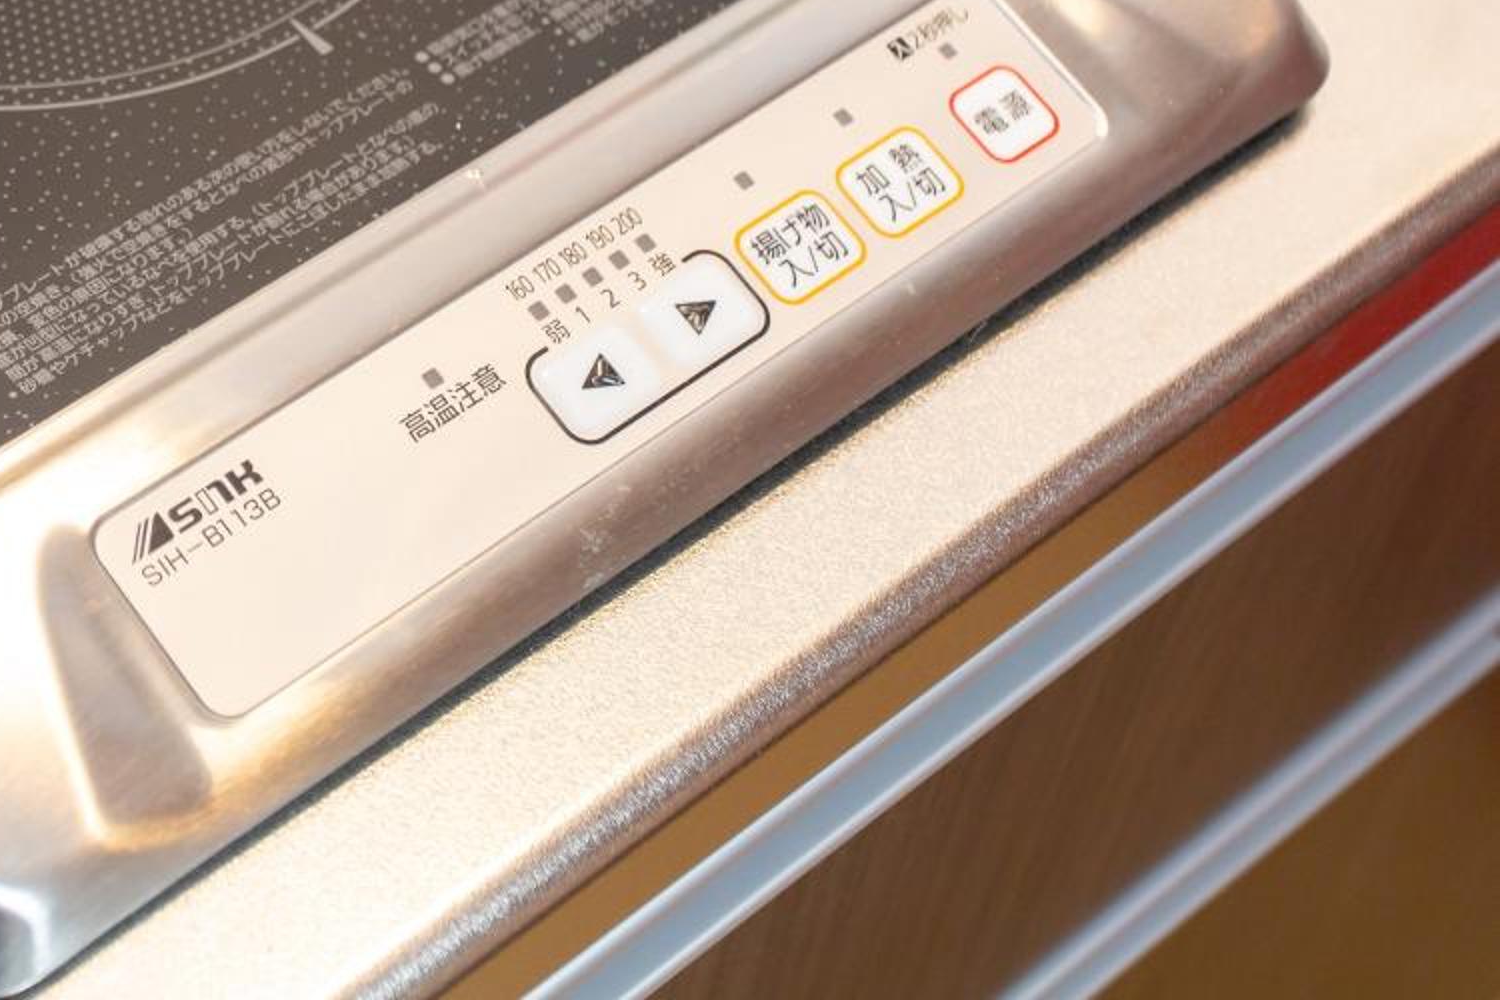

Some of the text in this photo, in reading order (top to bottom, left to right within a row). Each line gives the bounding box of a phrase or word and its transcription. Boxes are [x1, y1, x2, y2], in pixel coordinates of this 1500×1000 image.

[975, 88, 1031, 134] 電源
[879, 166, 946, 222] 入/切
[505, 207, 643, 301] 160 170 180 190 200
[750, 203, 830, 265] 揚げ物
[779, 231, 849, 288] 入/切
[541, 252, 677, 345] 弱 1 2 3 強
[399, 364, 507, 443] 高温注意
[141, 488, 281, 586] SIH-B113B
